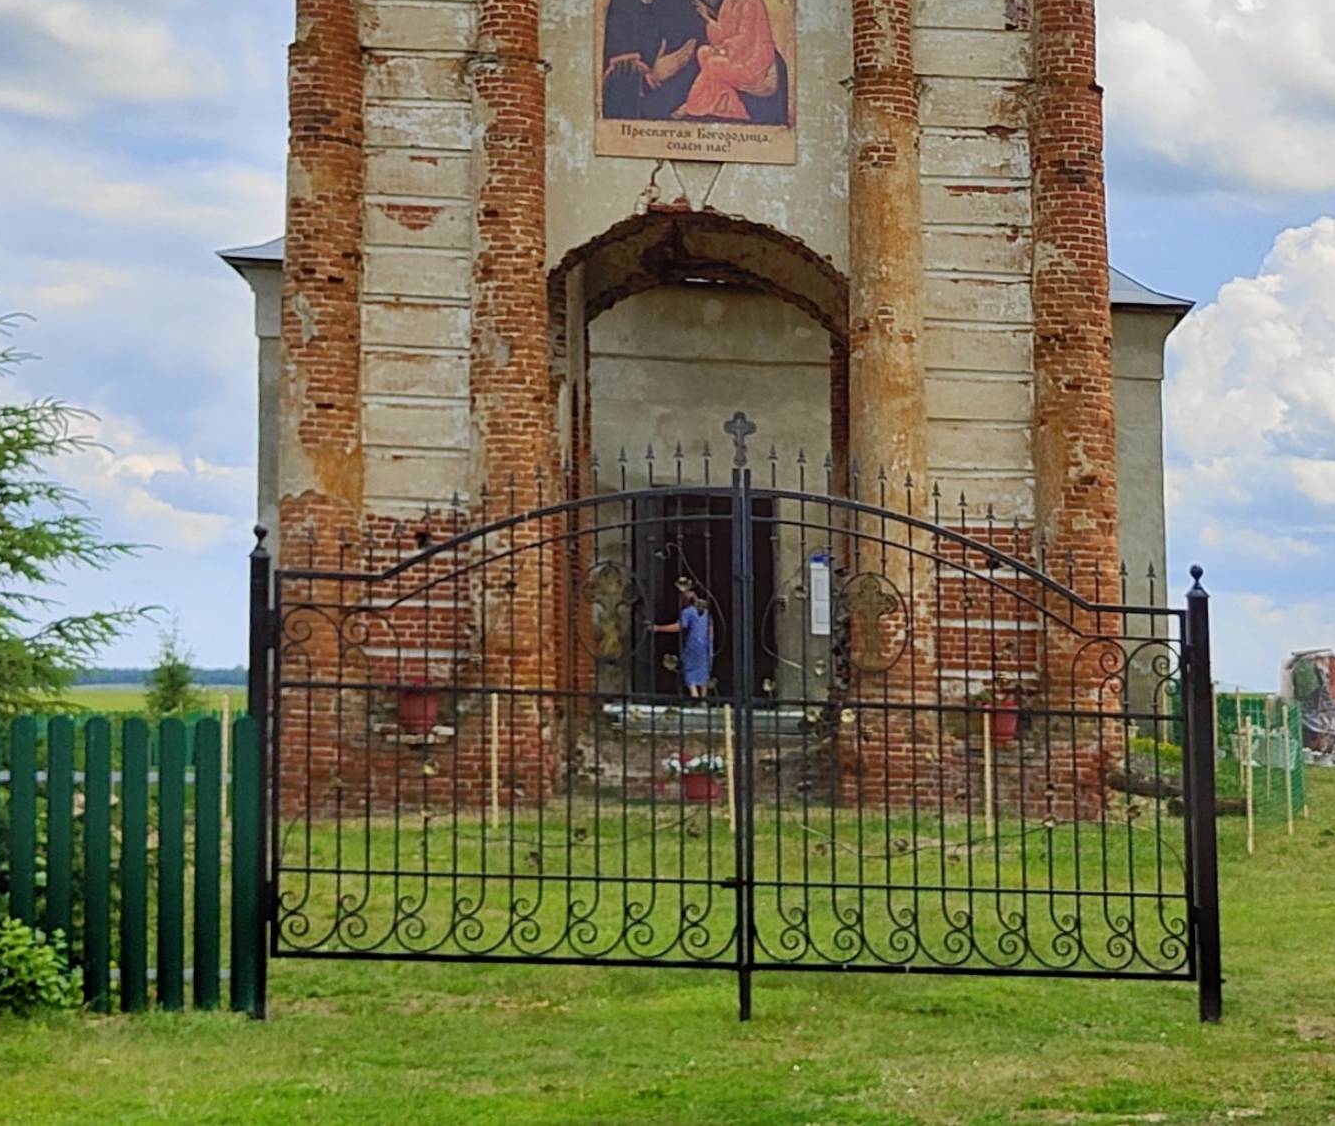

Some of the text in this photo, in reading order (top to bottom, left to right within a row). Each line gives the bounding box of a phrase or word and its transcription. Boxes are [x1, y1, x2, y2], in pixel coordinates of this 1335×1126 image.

[621, 124, 692, 138] Пресвятая
[666, 140, 732, 152] спаси нас!
